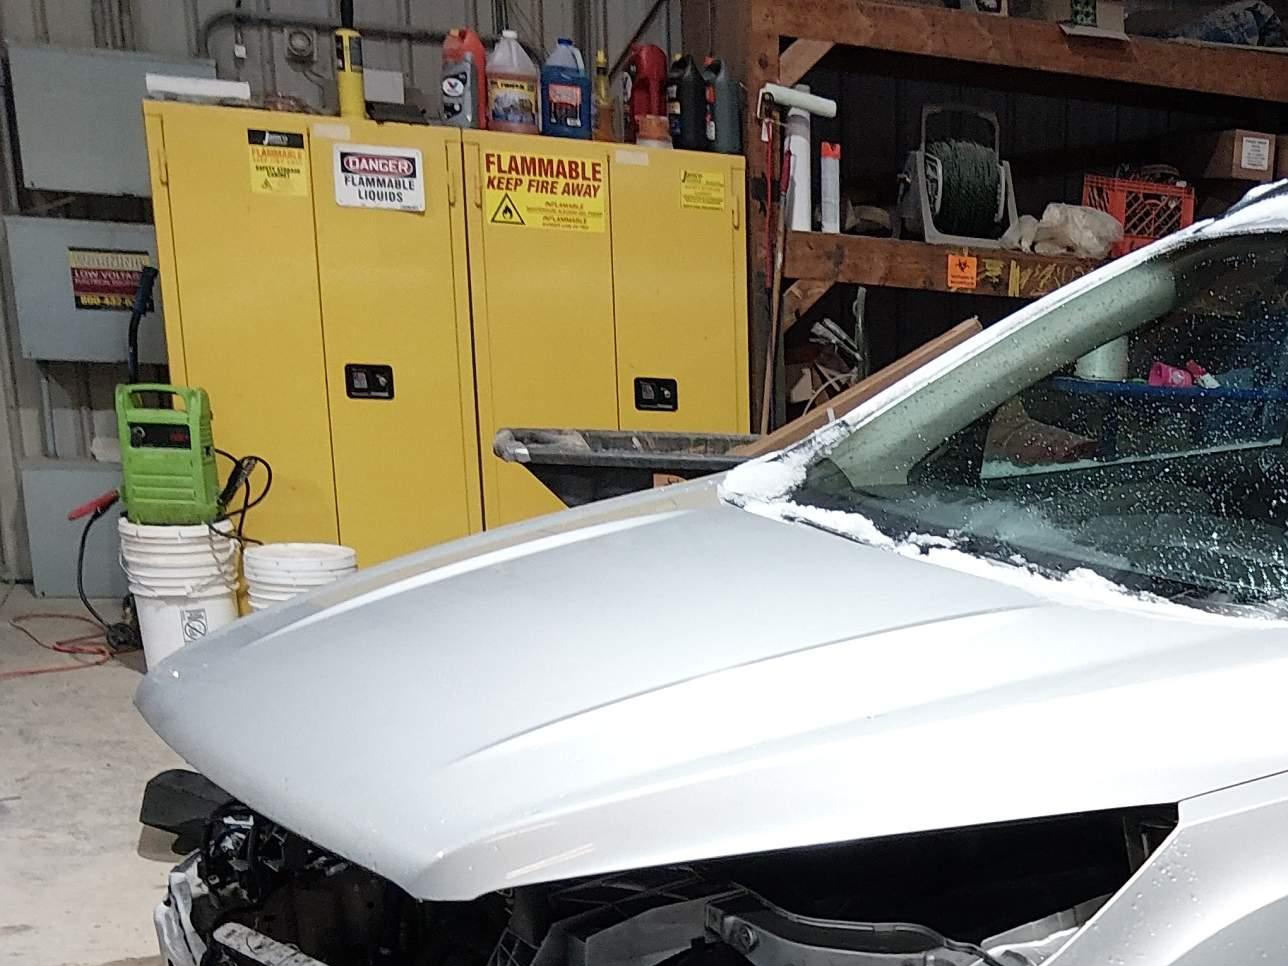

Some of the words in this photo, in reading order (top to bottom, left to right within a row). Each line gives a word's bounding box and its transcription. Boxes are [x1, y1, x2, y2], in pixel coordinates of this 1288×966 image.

[349, 156, 410, 174] DANGER
[485, 152, 602, 182] FLAMMABLE
[344, 175, 415, 190] FLAMMABLE
[487, 175, 523, 192] KEEP
[527, 179, 558, 196] FIRE
[562, 182, 601, 198] AWAY
[358, 189, 404, 202] LIQUIDS
[75, 271, 99, 280] LOW
